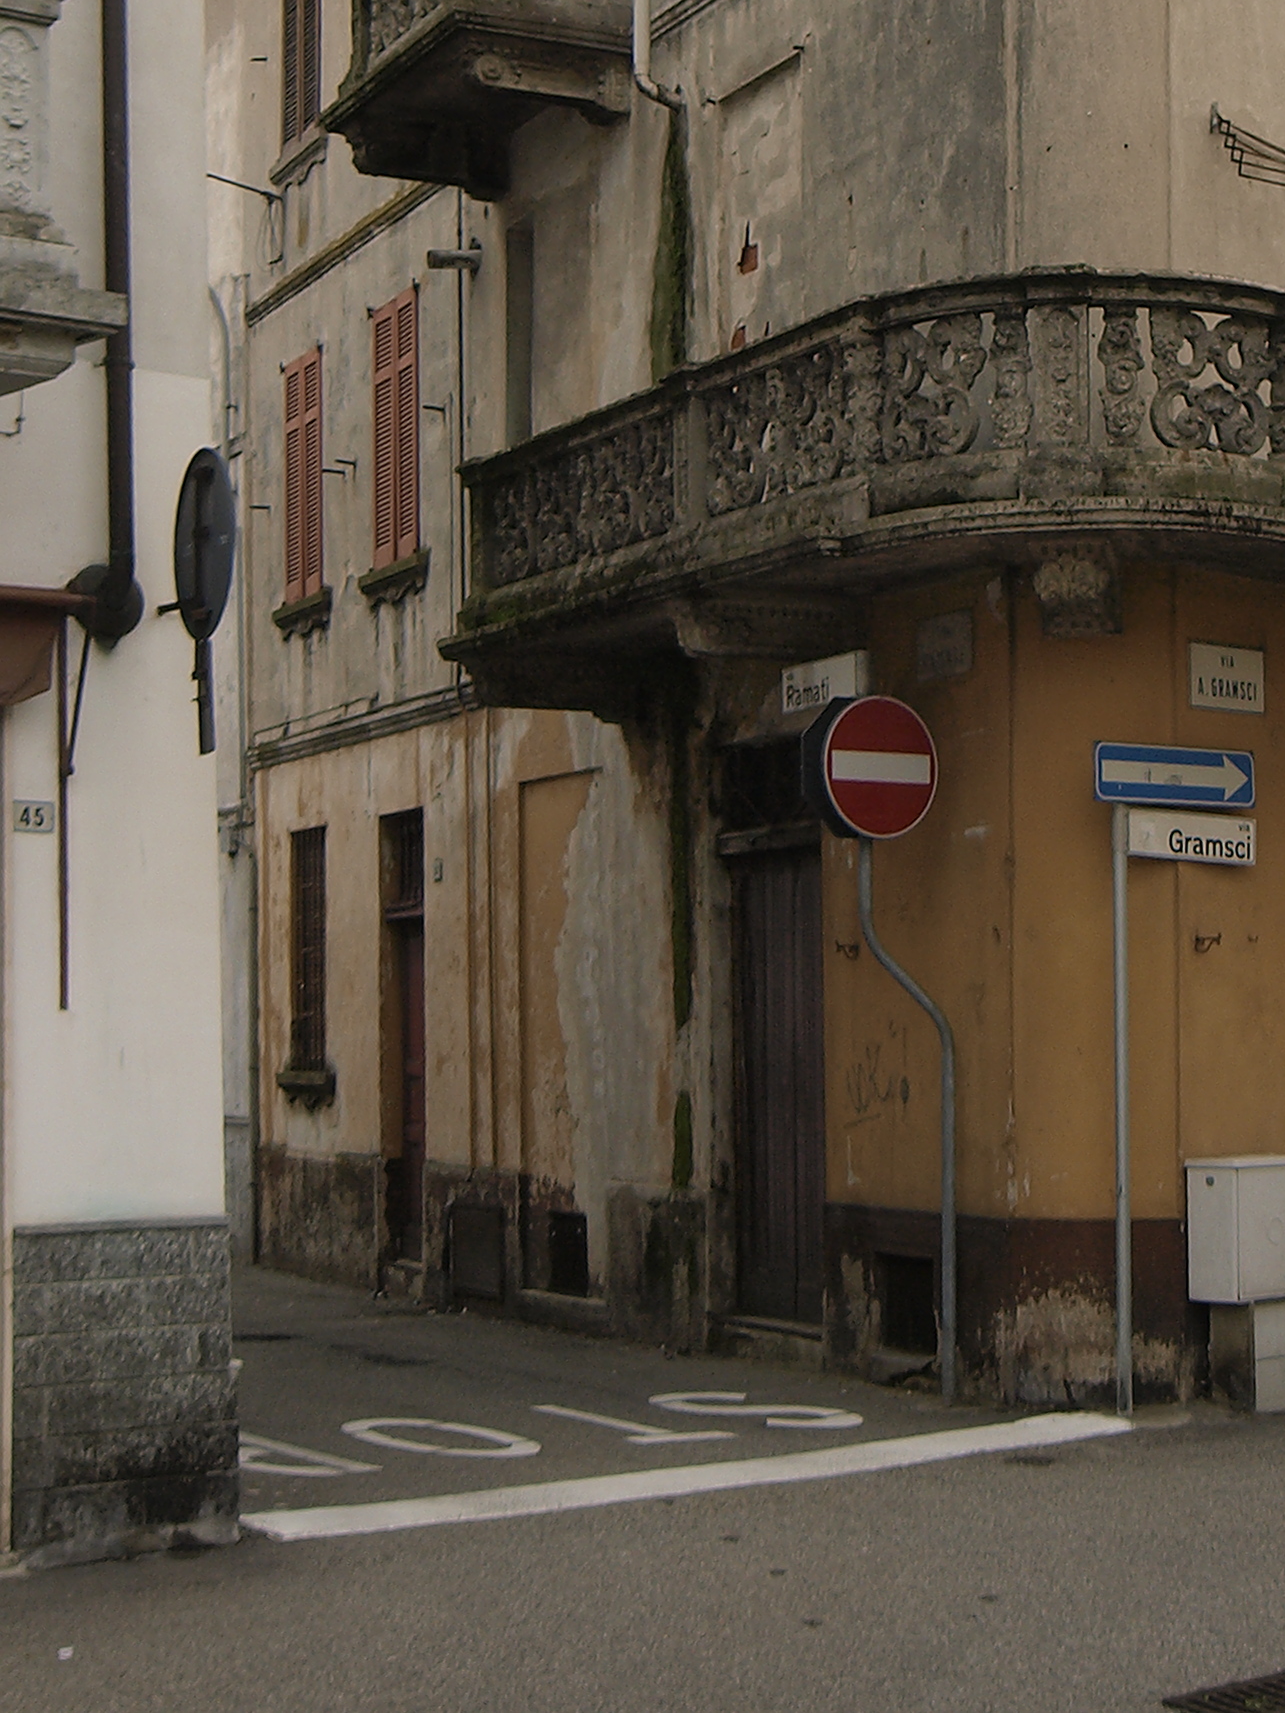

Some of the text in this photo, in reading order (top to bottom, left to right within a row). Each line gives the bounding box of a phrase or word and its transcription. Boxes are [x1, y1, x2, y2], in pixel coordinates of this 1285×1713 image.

[786, 676, 830, 708] Ramati
[19, 806, 44, 827] 45
[1169, 829, 1251, 860] Gramsci
